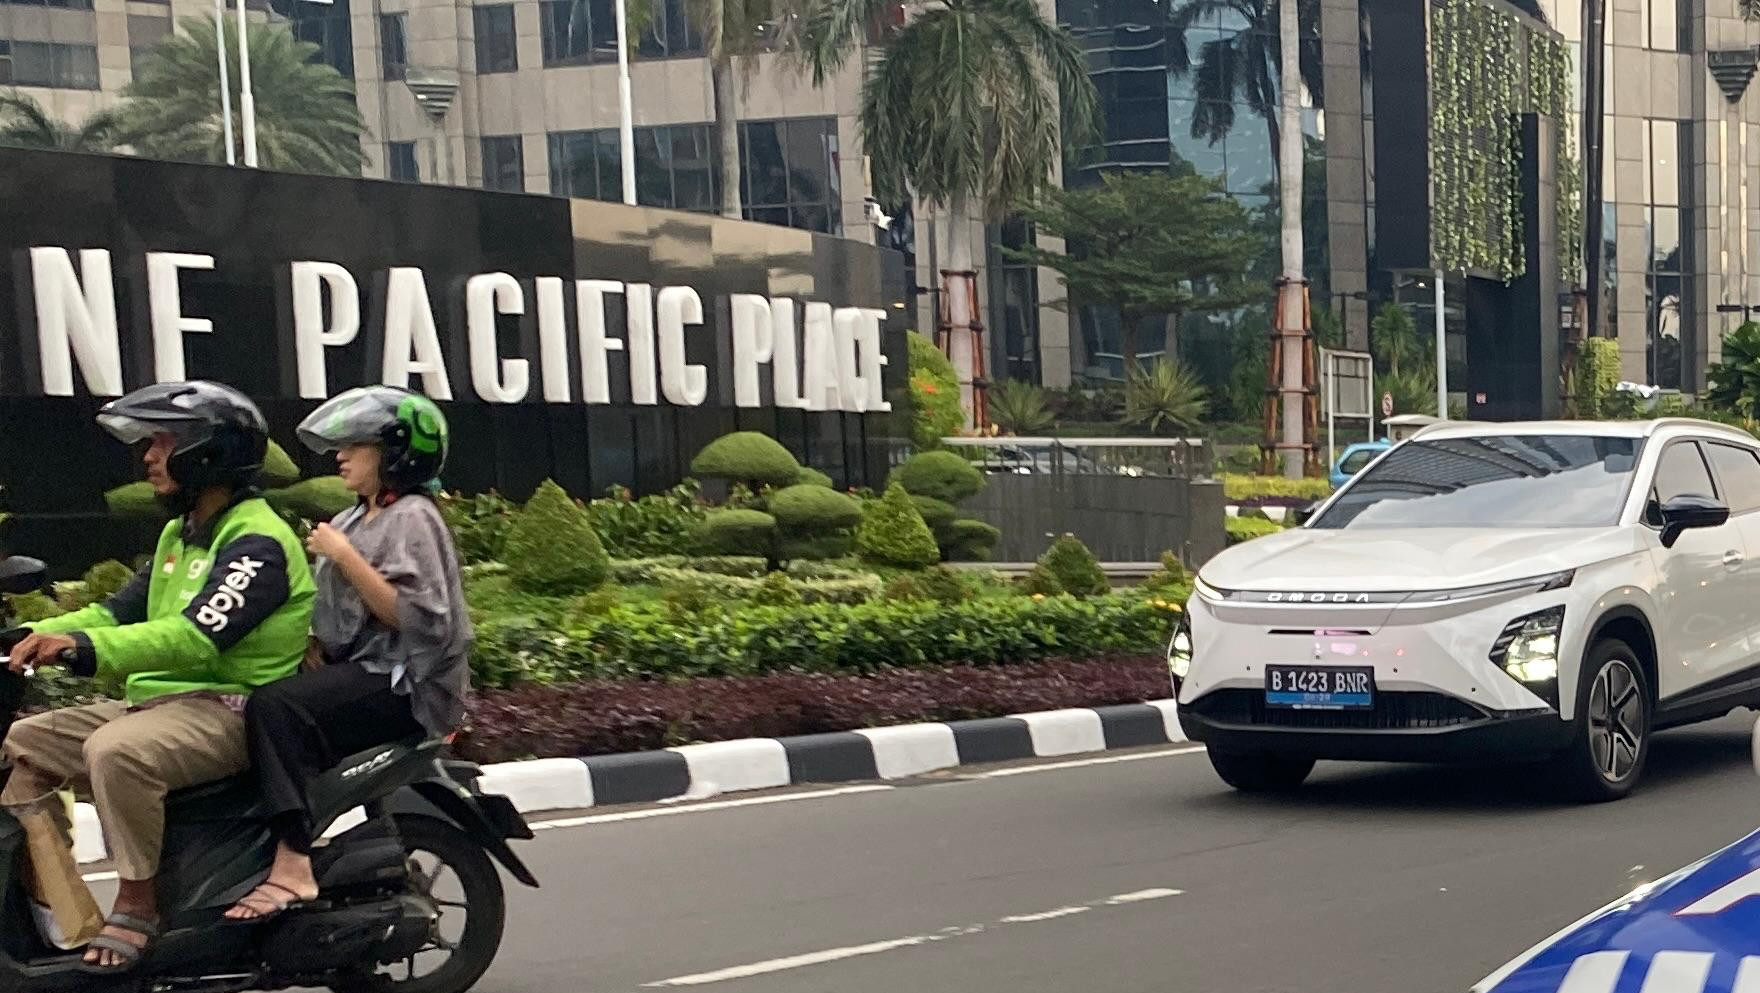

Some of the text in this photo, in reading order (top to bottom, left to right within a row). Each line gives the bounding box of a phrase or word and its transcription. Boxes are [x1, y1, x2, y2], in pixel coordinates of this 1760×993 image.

[290, 260, 708, 406] PACIFIC
[730, 293, 892, 413] PLACE
[195, 555, 265, 633] gojek
[1267, 592, 1369, 602] OMODA
[1271, 671, 1369, 693] B 1423 BNR
